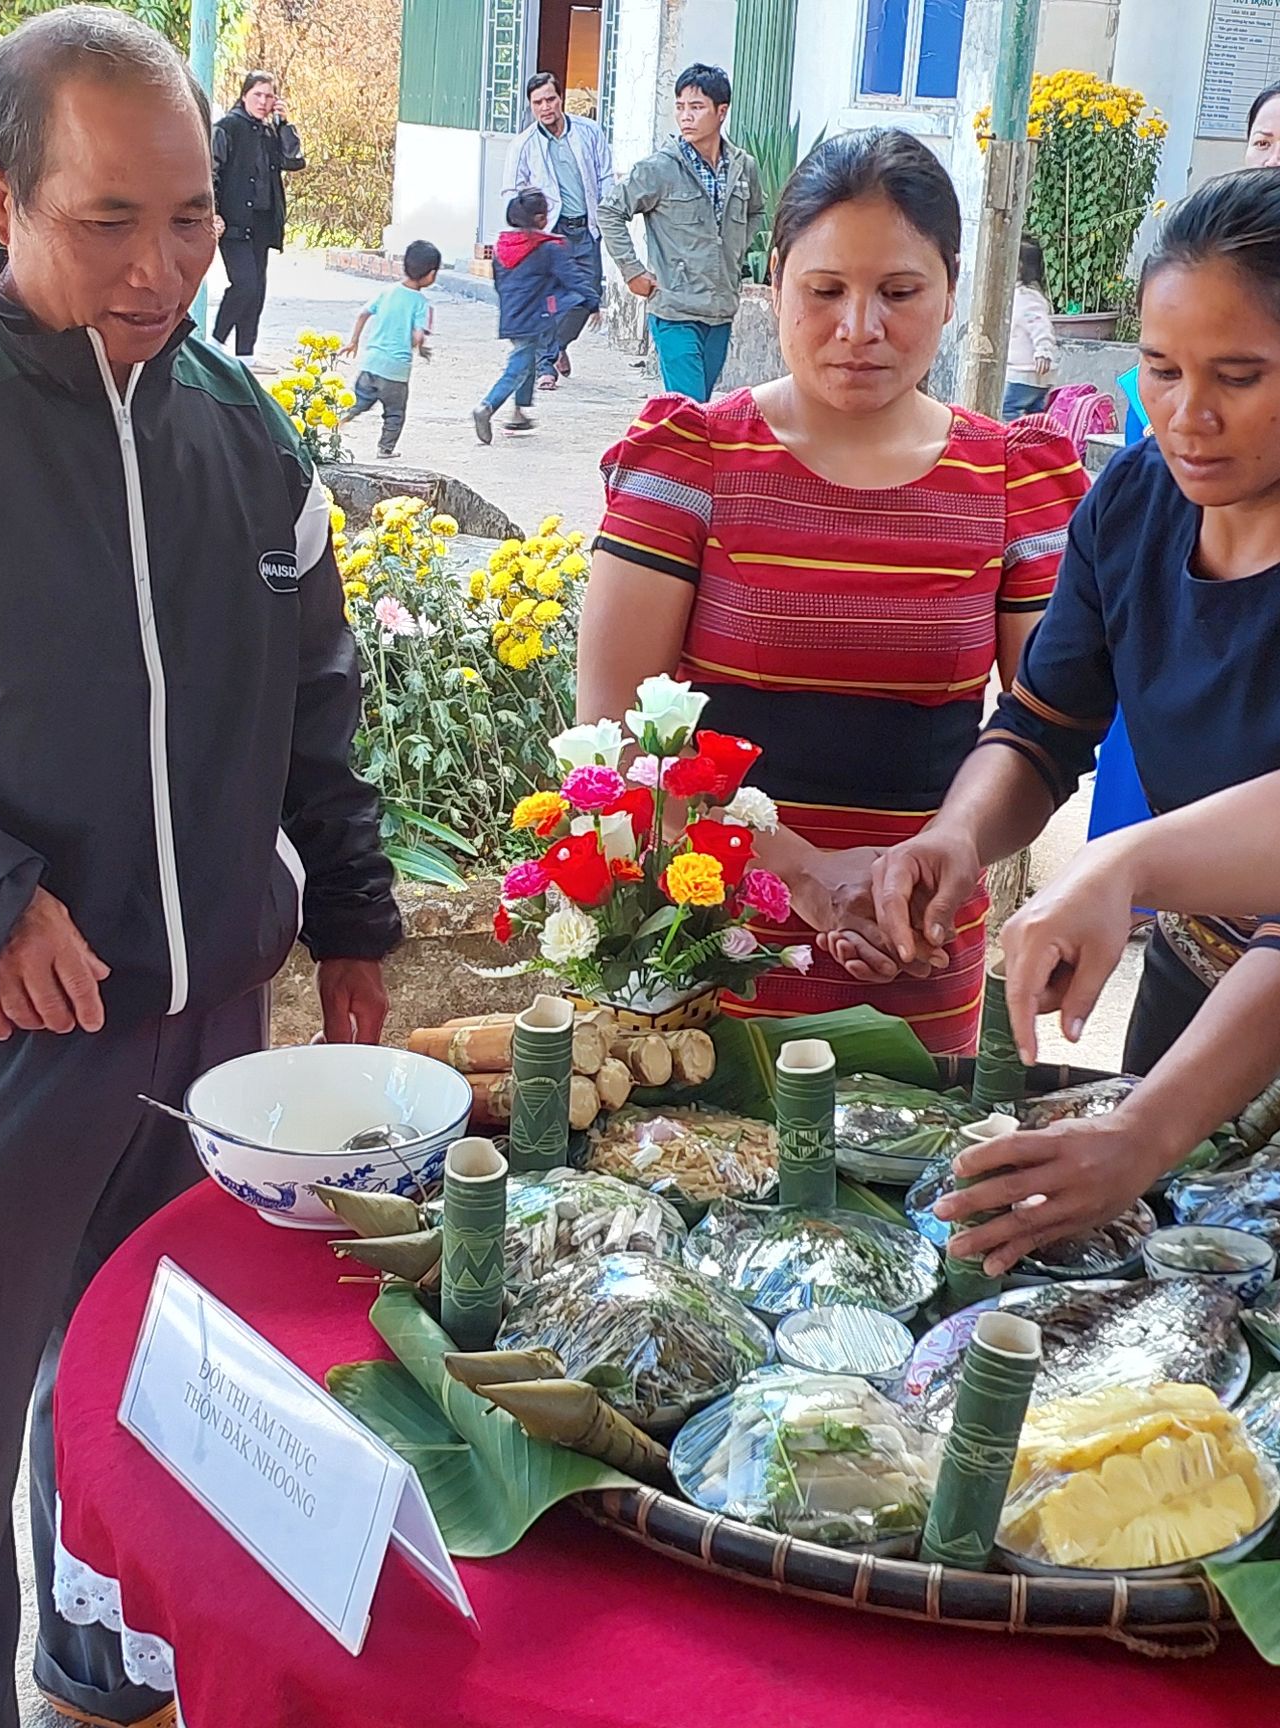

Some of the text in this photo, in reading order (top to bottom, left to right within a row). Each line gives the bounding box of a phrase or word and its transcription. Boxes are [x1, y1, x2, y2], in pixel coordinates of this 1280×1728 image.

[183, 1381, 223, 1431] THÔN
[251, 1444, 317, 1519] NHOONG
[198, 1357, 227, 1395] ĐỘI
[226, 1380, 251, 1417] THI
[277, 1424, 318, 1477] THỰC
